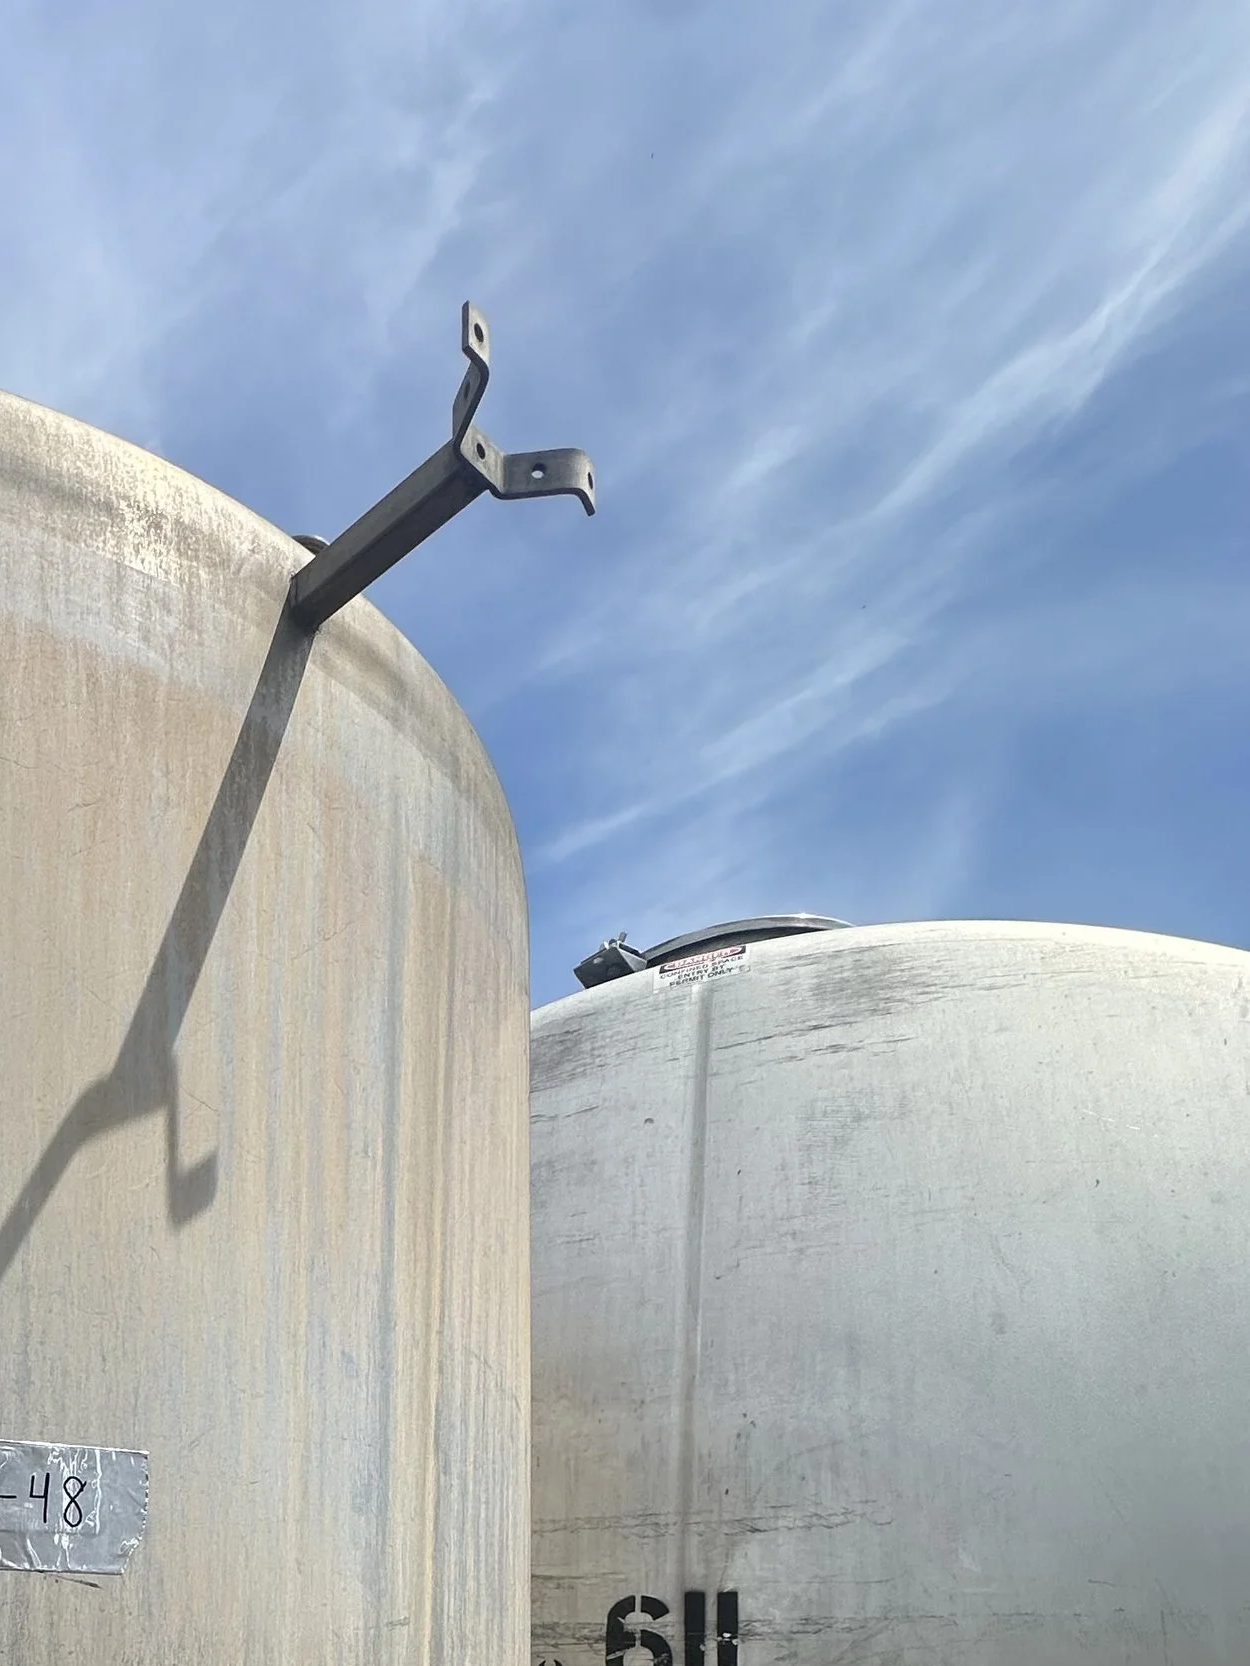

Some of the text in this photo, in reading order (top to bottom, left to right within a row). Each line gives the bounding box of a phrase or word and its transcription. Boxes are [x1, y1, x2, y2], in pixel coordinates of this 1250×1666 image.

[660, 955, 744, 979] CONFINED SPACE
[669, 967, 733, 987] PERMIT ONLY
[677, 964, 725, 980] ENTRY BY
